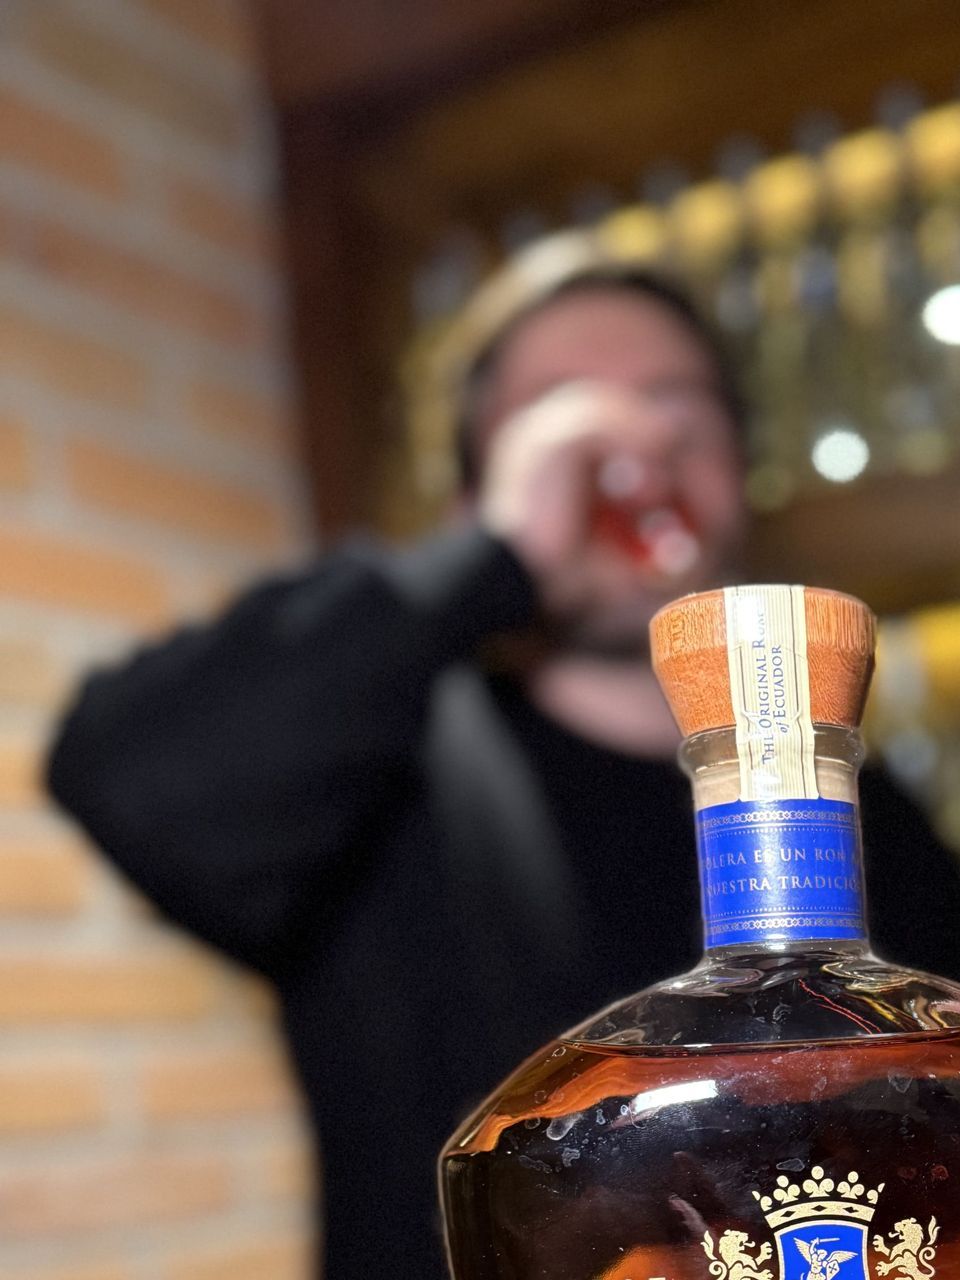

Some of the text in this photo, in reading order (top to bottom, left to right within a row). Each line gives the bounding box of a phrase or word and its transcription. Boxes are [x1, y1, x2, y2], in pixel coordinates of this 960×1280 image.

[757, 655, 773, 729] ORIGINAL
[772, 645, 787, 719] ECUADOR
[780, 848, 806, 862] UN
